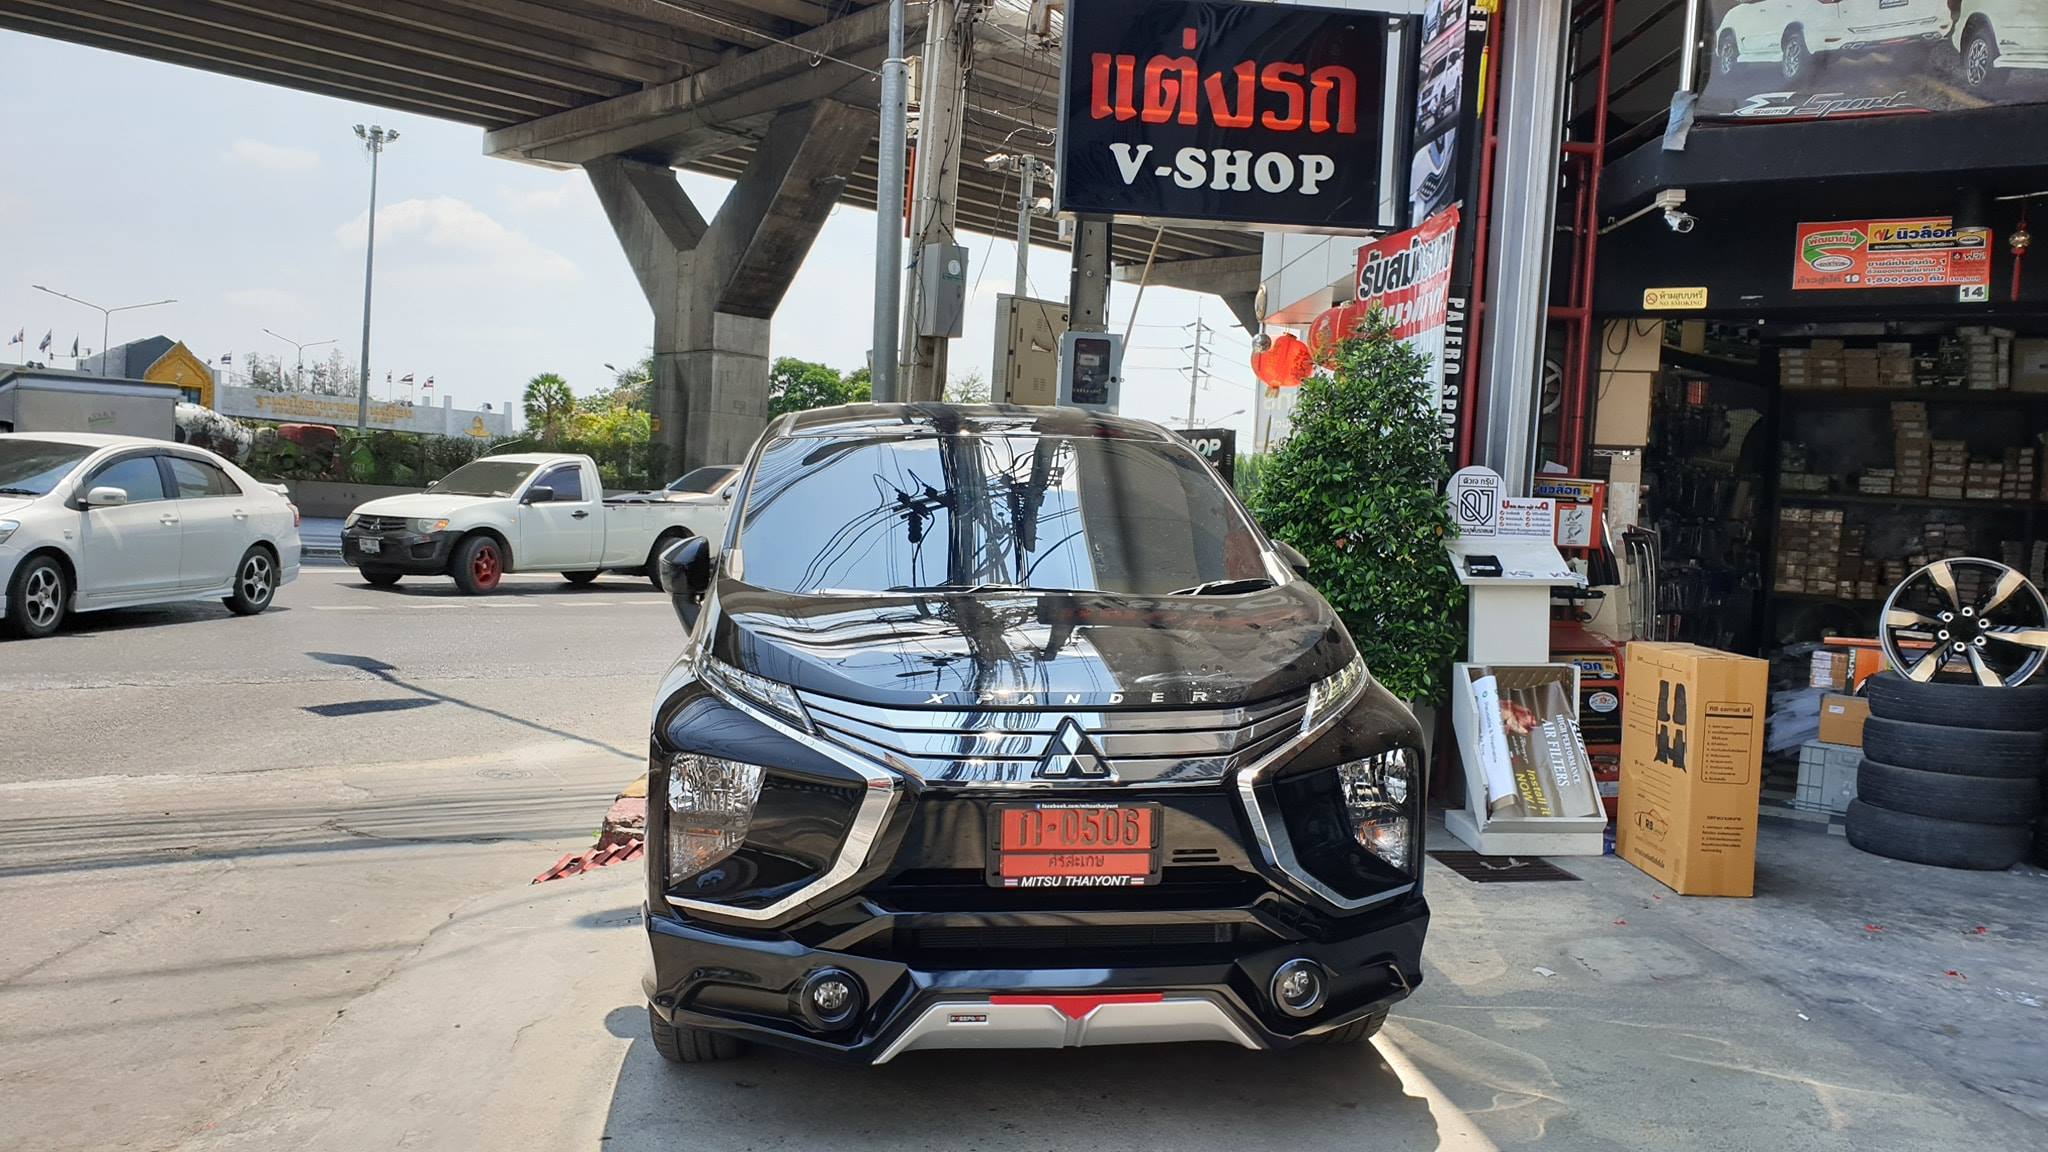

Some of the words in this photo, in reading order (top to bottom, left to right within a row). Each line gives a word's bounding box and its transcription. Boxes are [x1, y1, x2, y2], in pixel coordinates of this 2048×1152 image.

[1091, 27, 1357, 133] แต่งรถ
[1109, 143, 1335, 195] V-SHOP
[1961, 287, 1984, 298] 14
[1444, 298, 1465, 375] PAJERO
[925, 692, 1209, 704] XPANDER
[1542, 718, 1557, 738] AIR
[1547, 740, 1570, 787] FILTERS
[1526, 769, 1548, 806] Install
[1048, 855, 1105, 868] ศรสะเกษ
[1021, 876, 1063, 887] MITSU
[1065, 875, 1130, 886] THAIYONT
